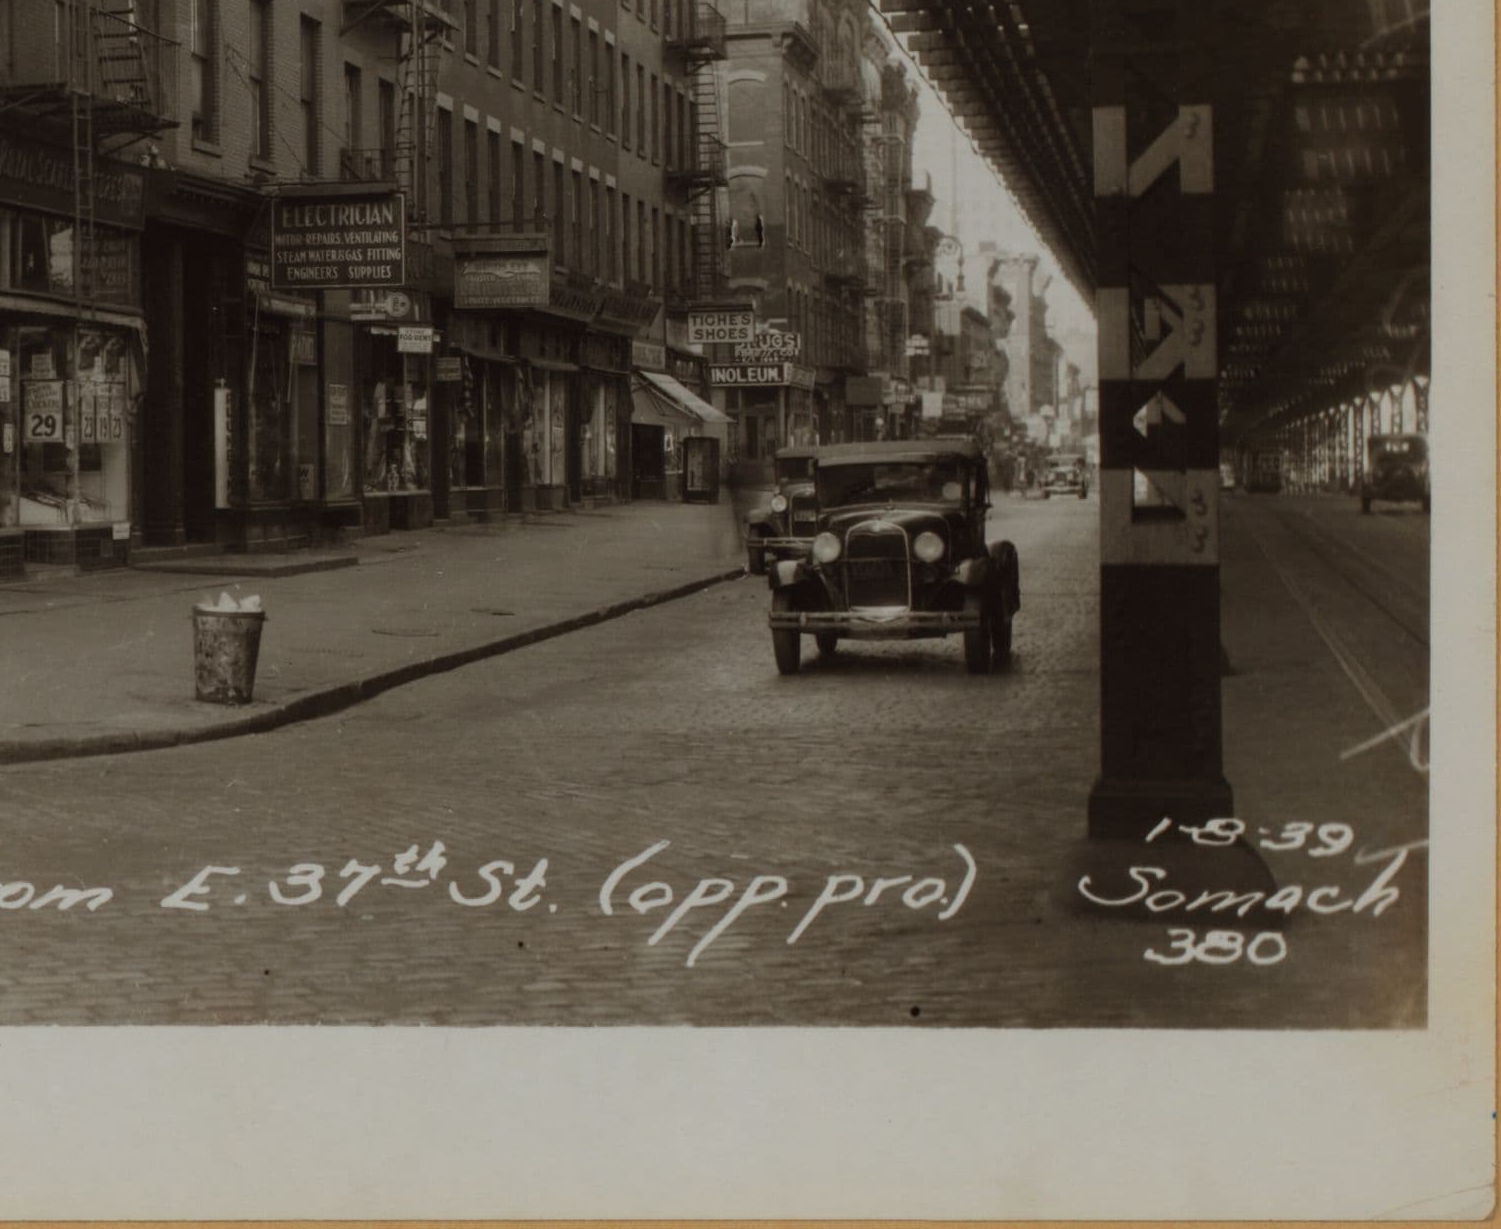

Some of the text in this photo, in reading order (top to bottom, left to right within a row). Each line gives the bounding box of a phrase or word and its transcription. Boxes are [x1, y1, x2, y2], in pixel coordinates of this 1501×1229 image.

[282, 202, 394, 228] ELECTRICIAN
[343, 230, 399, 244] VENTILATING
[276, 250, 307, 264] STEAM
[366, 247, 401, 261] FITTING
[347, 264, 392, 279] SUPPLIES
[694, 328, 749, 340] SHOES
[31, 414, 57, 437] 29
